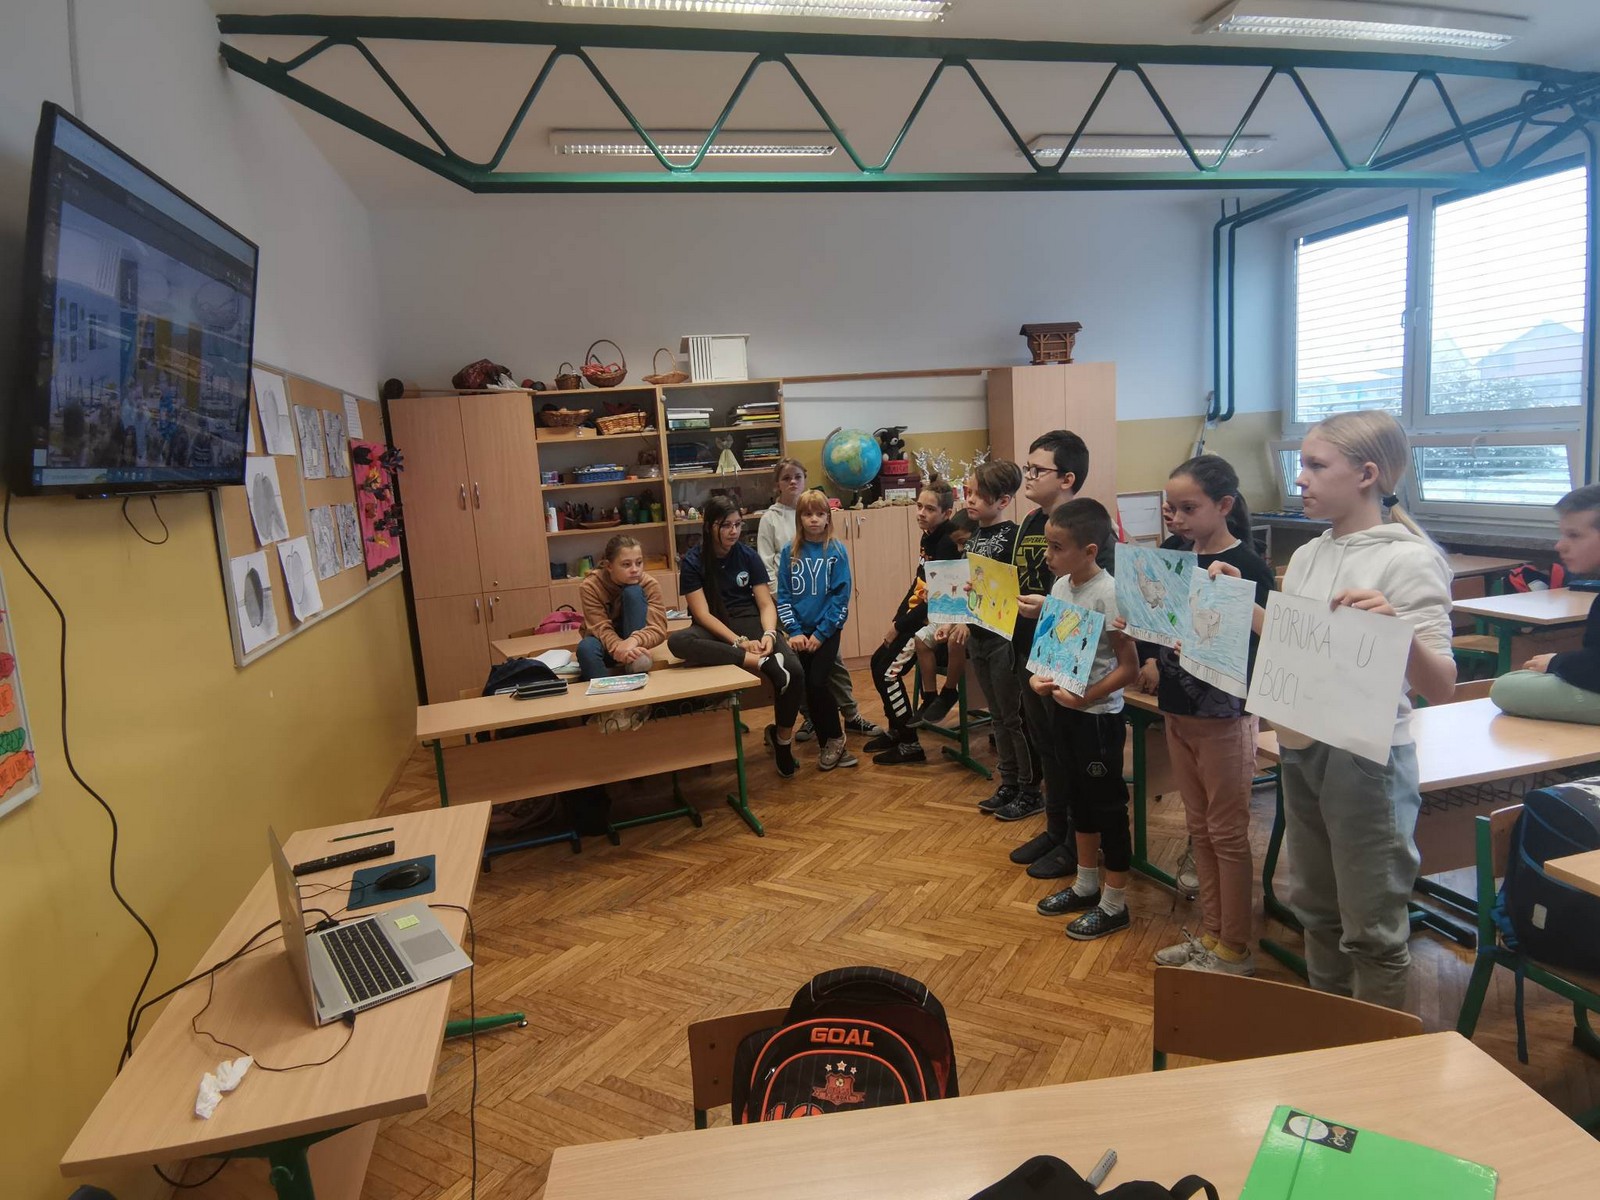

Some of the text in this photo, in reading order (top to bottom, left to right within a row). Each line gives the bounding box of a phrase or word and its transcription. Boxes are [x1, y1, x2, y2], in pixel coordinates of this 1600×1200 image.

[1269, 603, 1377, 668] PORUKA U
[1259, 659, 1299, 709] BOCI
[811, 1027, 875, 1047] GOAL
